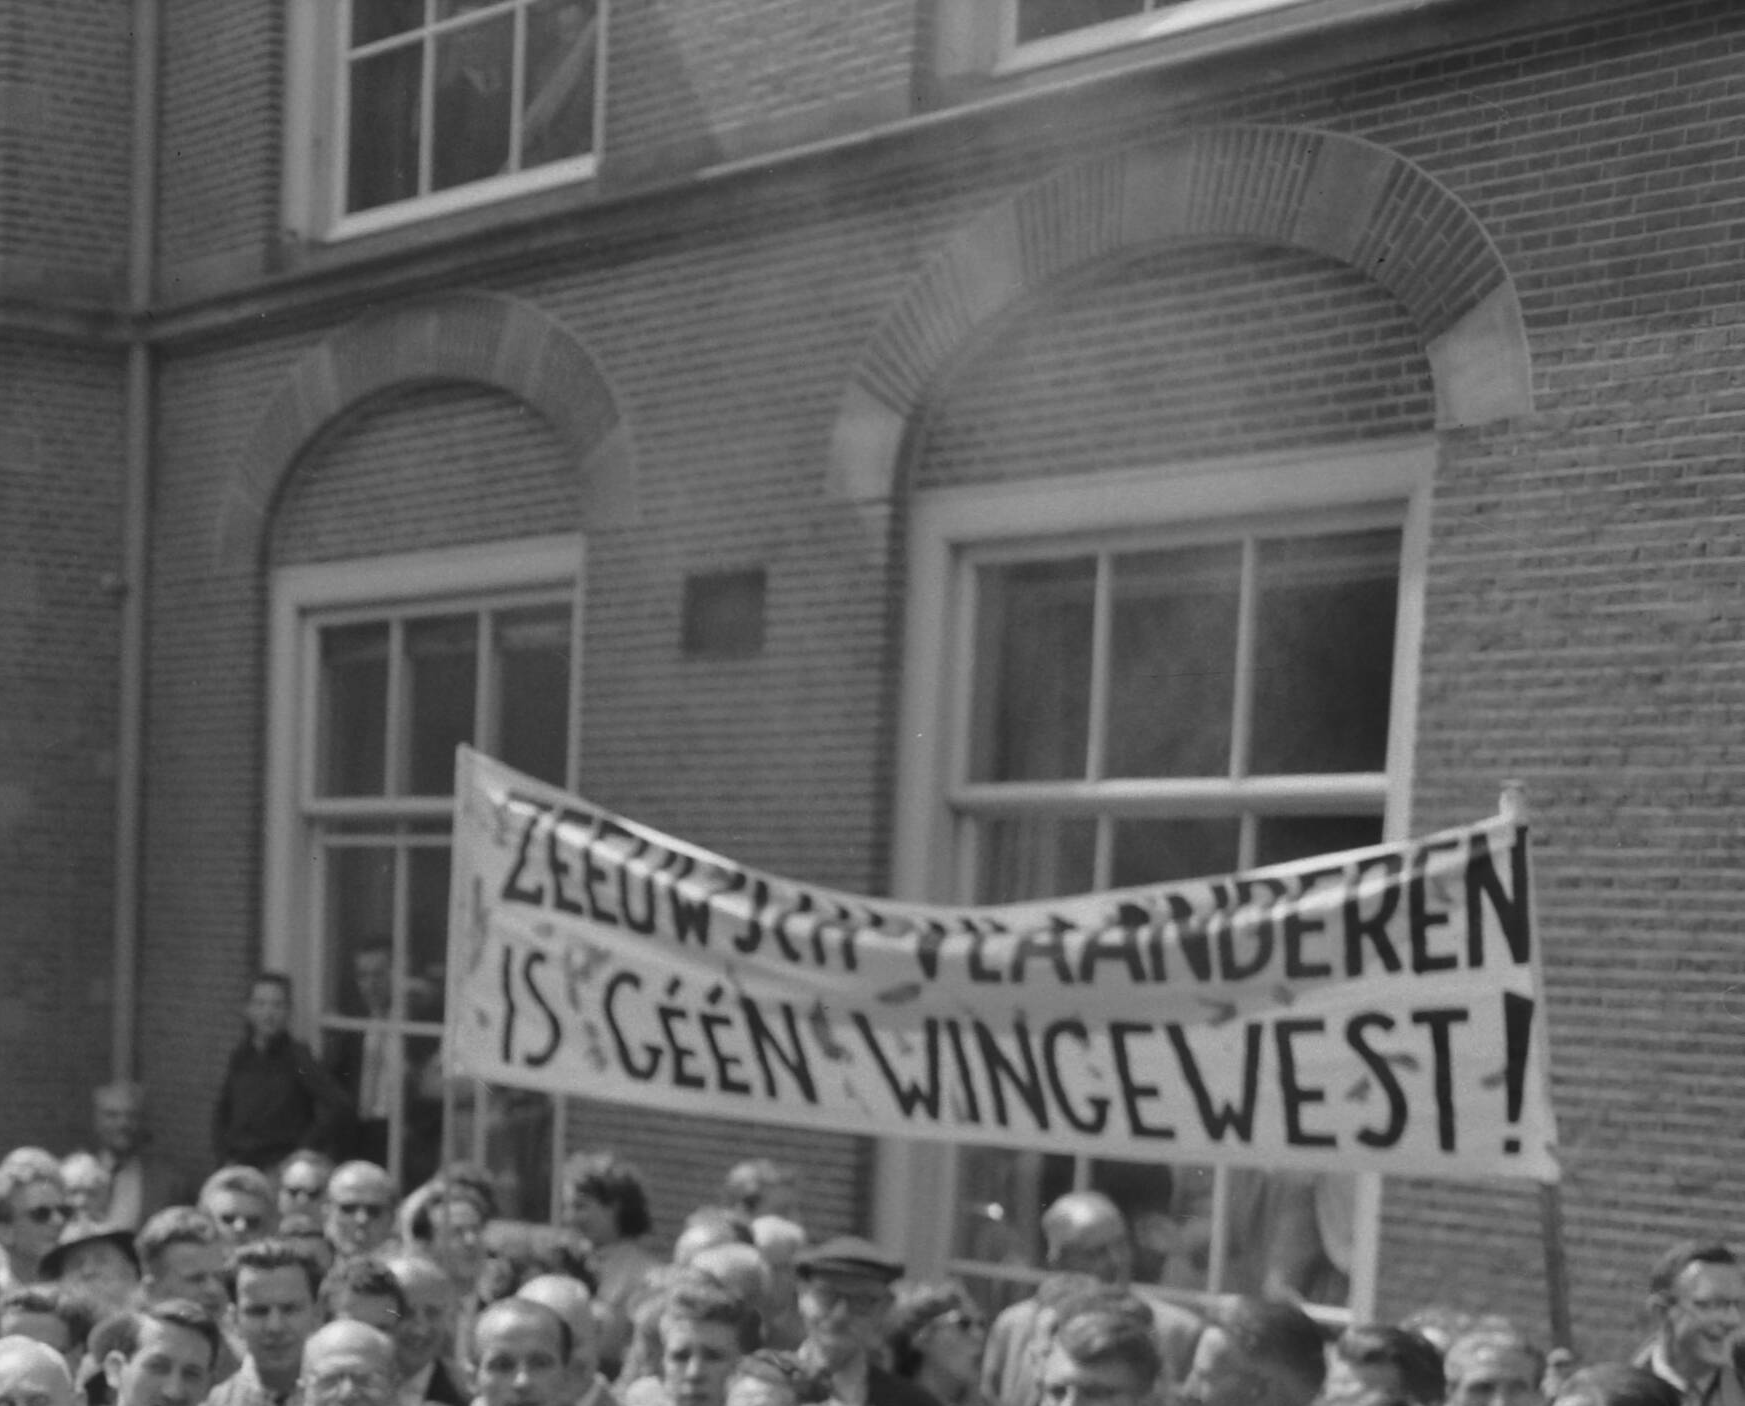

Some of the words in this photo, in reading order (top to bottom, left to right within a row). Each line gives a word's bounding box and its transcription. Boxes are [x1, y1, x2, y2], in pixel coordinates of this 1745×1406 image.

[502, 945, 561, 1066] IS
[604, 971, 819, 1104] GÉÉN
[851, 991, 1535, 1154] WINGEWEST!
